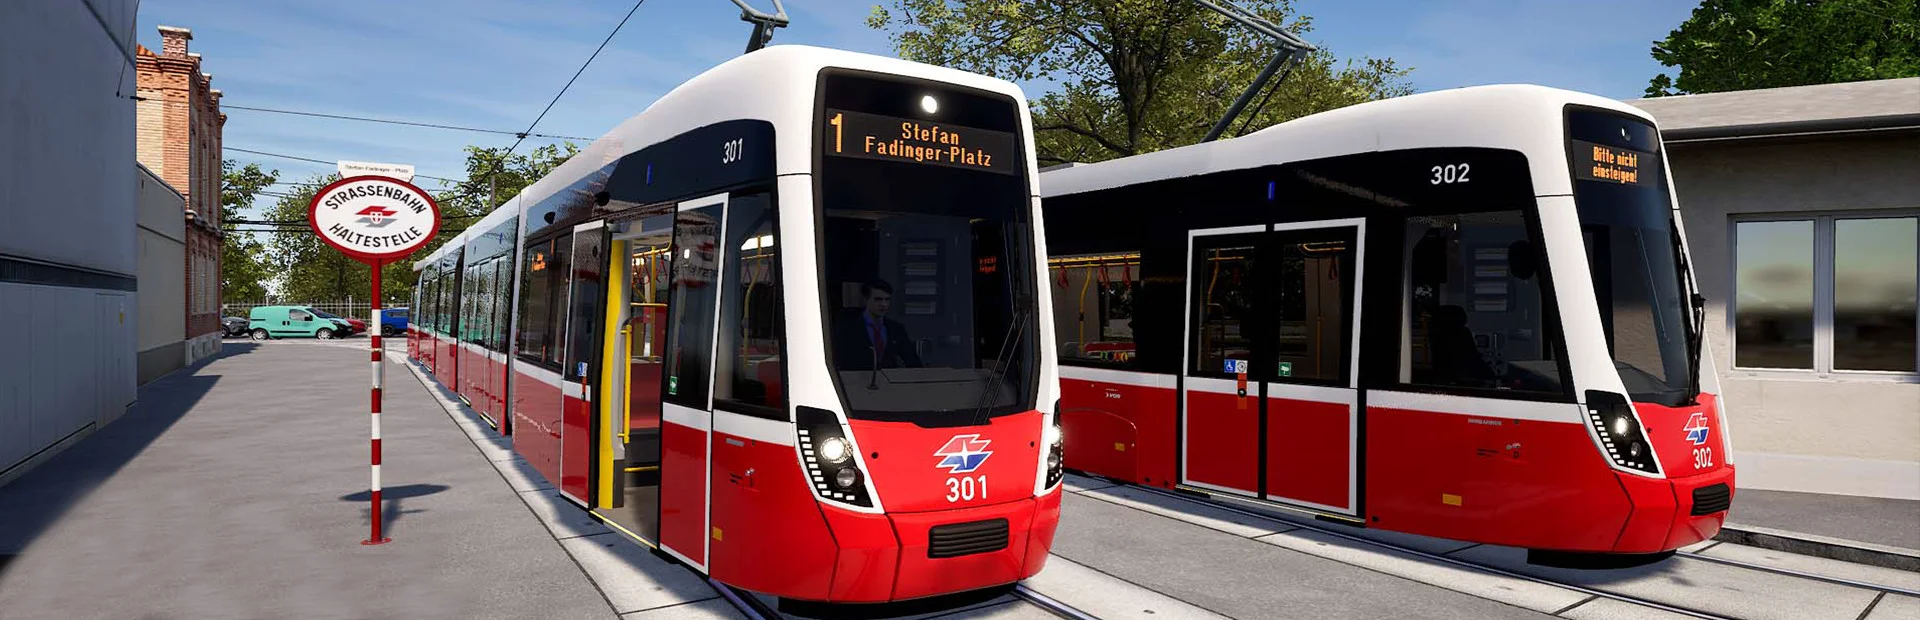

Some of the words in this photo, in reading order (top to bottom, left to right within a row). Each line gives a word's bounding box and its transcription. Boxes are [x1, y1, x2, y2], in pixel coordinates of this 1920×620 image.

[830, 113, 843, 153] 1
[902, 122, 959, 146] Stefan
[723, 138, 743, 164] 301
[865, 136, 992, 167] Fadinger-Platz
[1593, 146, 1615, 164] Bitte
[1617, 152, 1637, 167] nicht
[1431, 163, 1470, 185] 302
[1593, 163, 1637, 183] einsteigen!
[325, 185, 427, 214] STRASSENBAHN
[329, 223, 422, 248] HALTESTELLE
[1693, 447, 1714, 470] 302
[945, 475, 987, 503] 301
